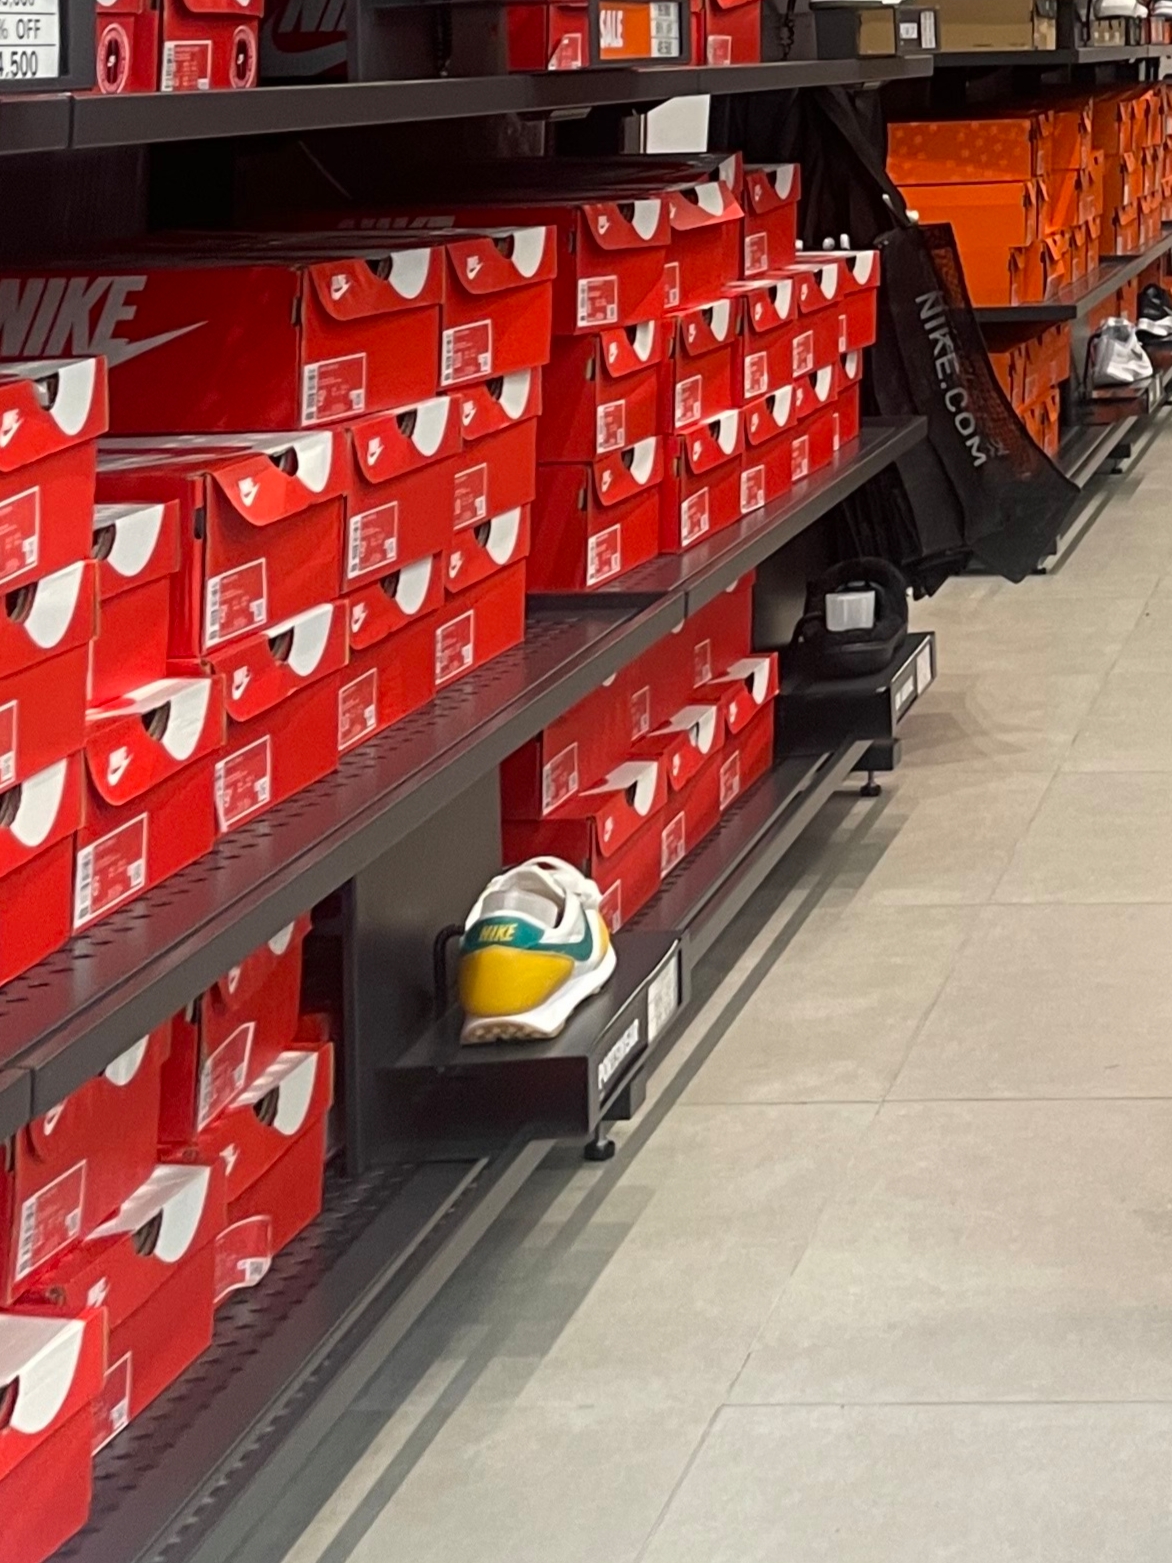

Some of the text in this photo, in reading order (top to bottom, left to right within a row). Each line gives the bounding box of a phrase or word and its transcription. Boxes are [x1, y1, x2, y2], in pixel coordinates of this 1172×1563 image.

[16, 18, 41, 40] OFF
[599, 10, 624, 50] SALE
[0, 275, 148, 358] NIKE
[915, 290, 988, 468] NIKE.COM
[479, 922, 519, 942] NIKE
